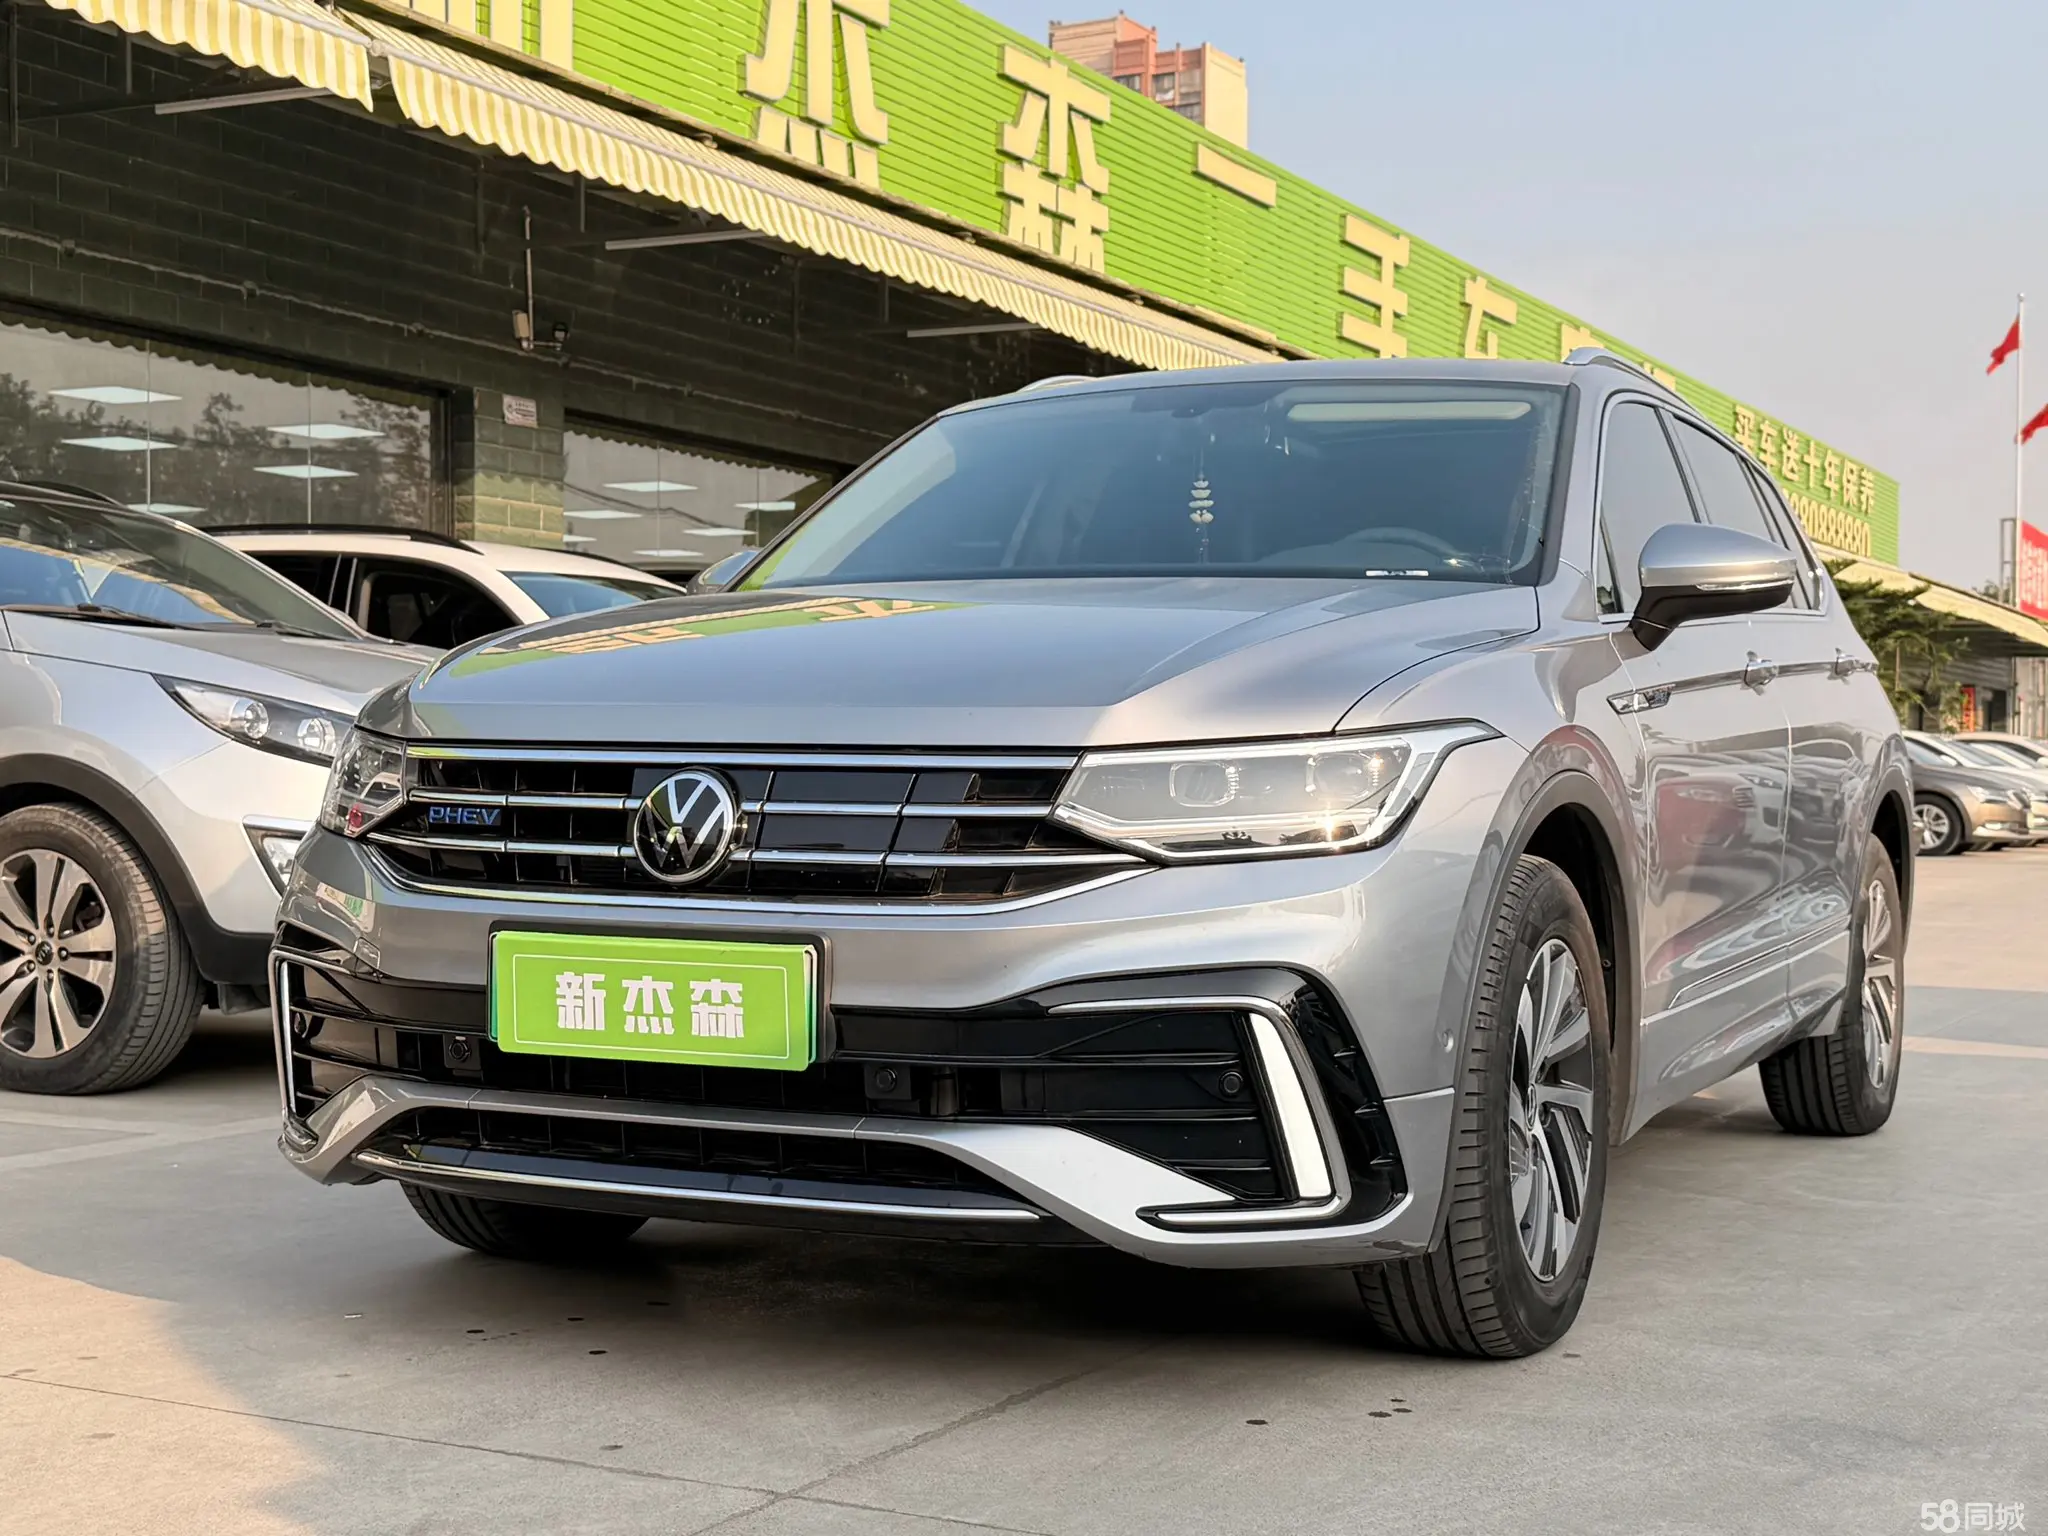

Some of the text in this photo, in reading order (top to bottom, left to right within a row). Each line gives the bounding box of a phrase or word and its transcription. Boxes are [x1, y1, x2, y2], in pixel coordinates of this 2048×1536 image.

[1735, 405, 1875, 515] 买车送十年保养
[428, 806, 501, 826] PHEV
[555, 971, 744, 1038] 新杰森
